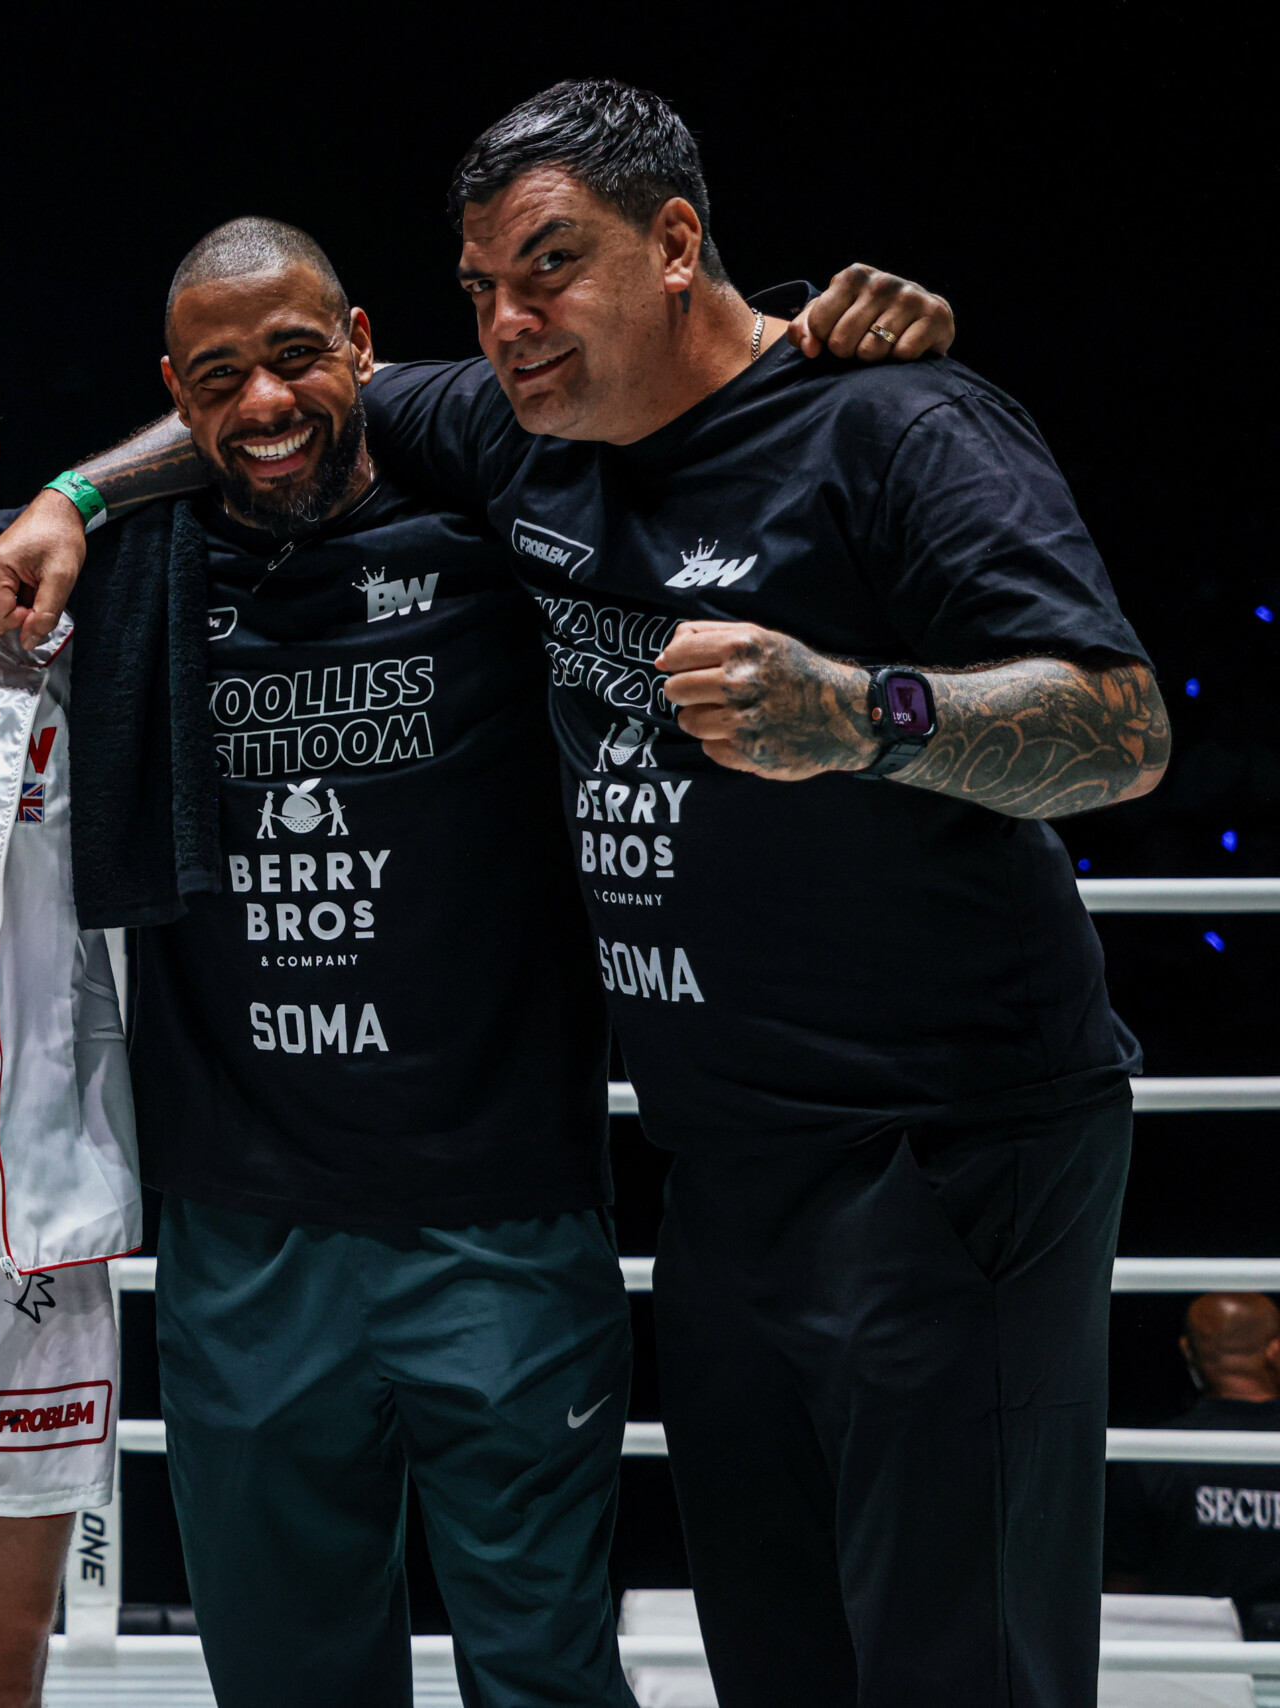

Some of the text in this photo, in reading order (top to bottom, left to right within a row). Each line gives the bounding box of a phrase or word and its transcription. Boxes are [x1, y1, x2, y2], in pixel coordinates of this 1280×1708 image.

[520, 534, 572, 567] PROBLEM
[664, 554, 758, 589] BW
[367, 572, 439, 623] BW
[207, 656, 434, 727] OOLLISS
[576, 780, 692, 823] BERRY
[228, 850, 391, 893] BERRY
[602, 890, 662, 906] COMPANY
[261, 954, 359, 967] & COMPANY
[598, 936, 705, 1003] SOMA
[249, 1001, 390, 1054] SOMA
[76, 1511, 111, 1587] ONE
